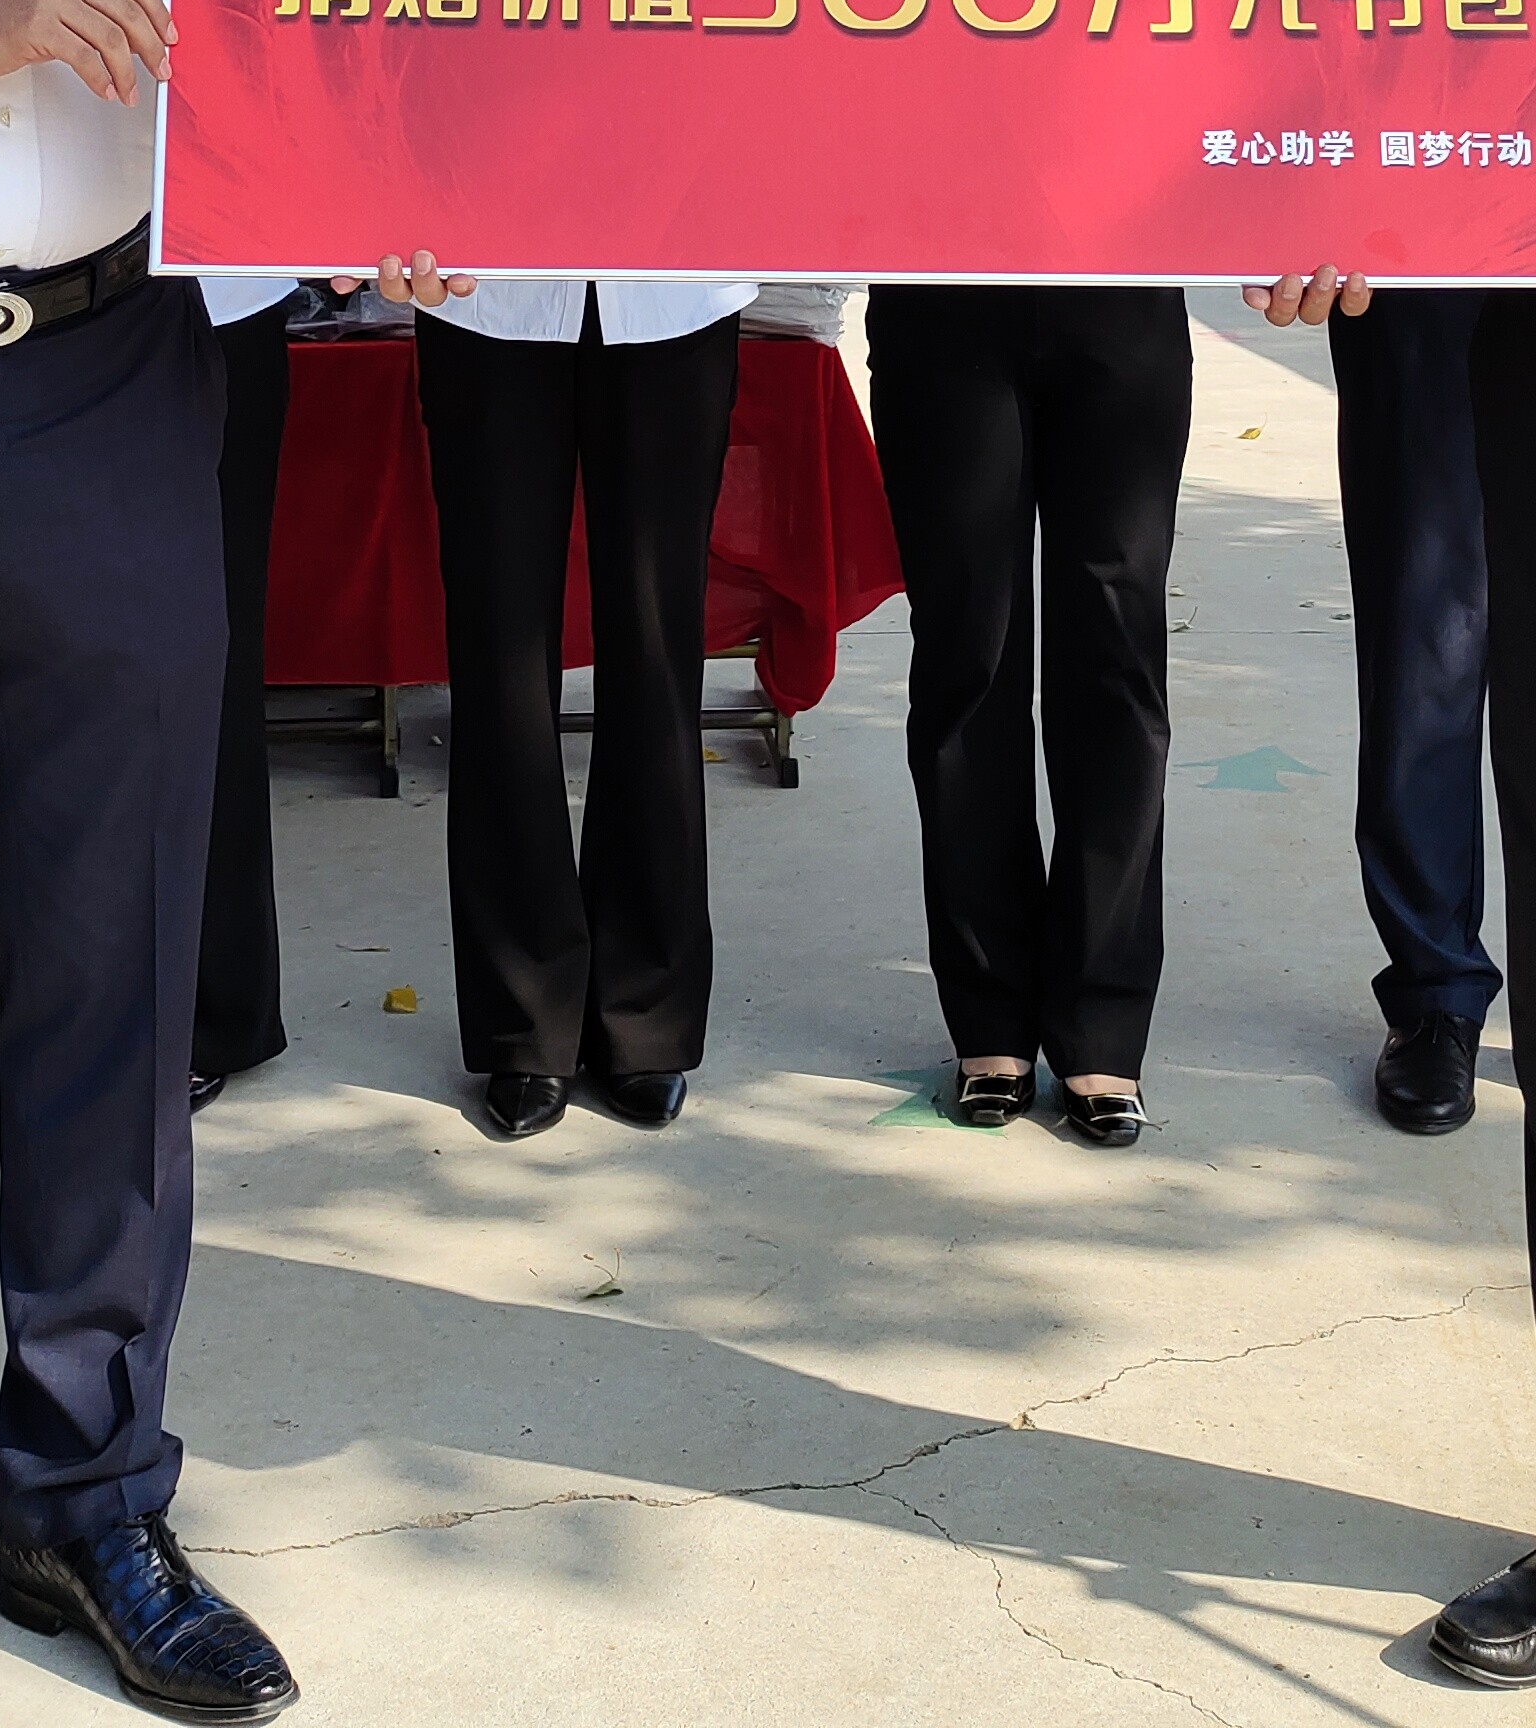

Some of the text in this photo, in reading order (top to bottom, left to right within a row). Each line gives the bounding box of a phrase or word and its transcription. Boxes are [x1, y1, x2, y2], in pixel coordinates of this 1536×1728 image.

[1202, 130, 1532, 168] 爱心助学 圆梦行动
